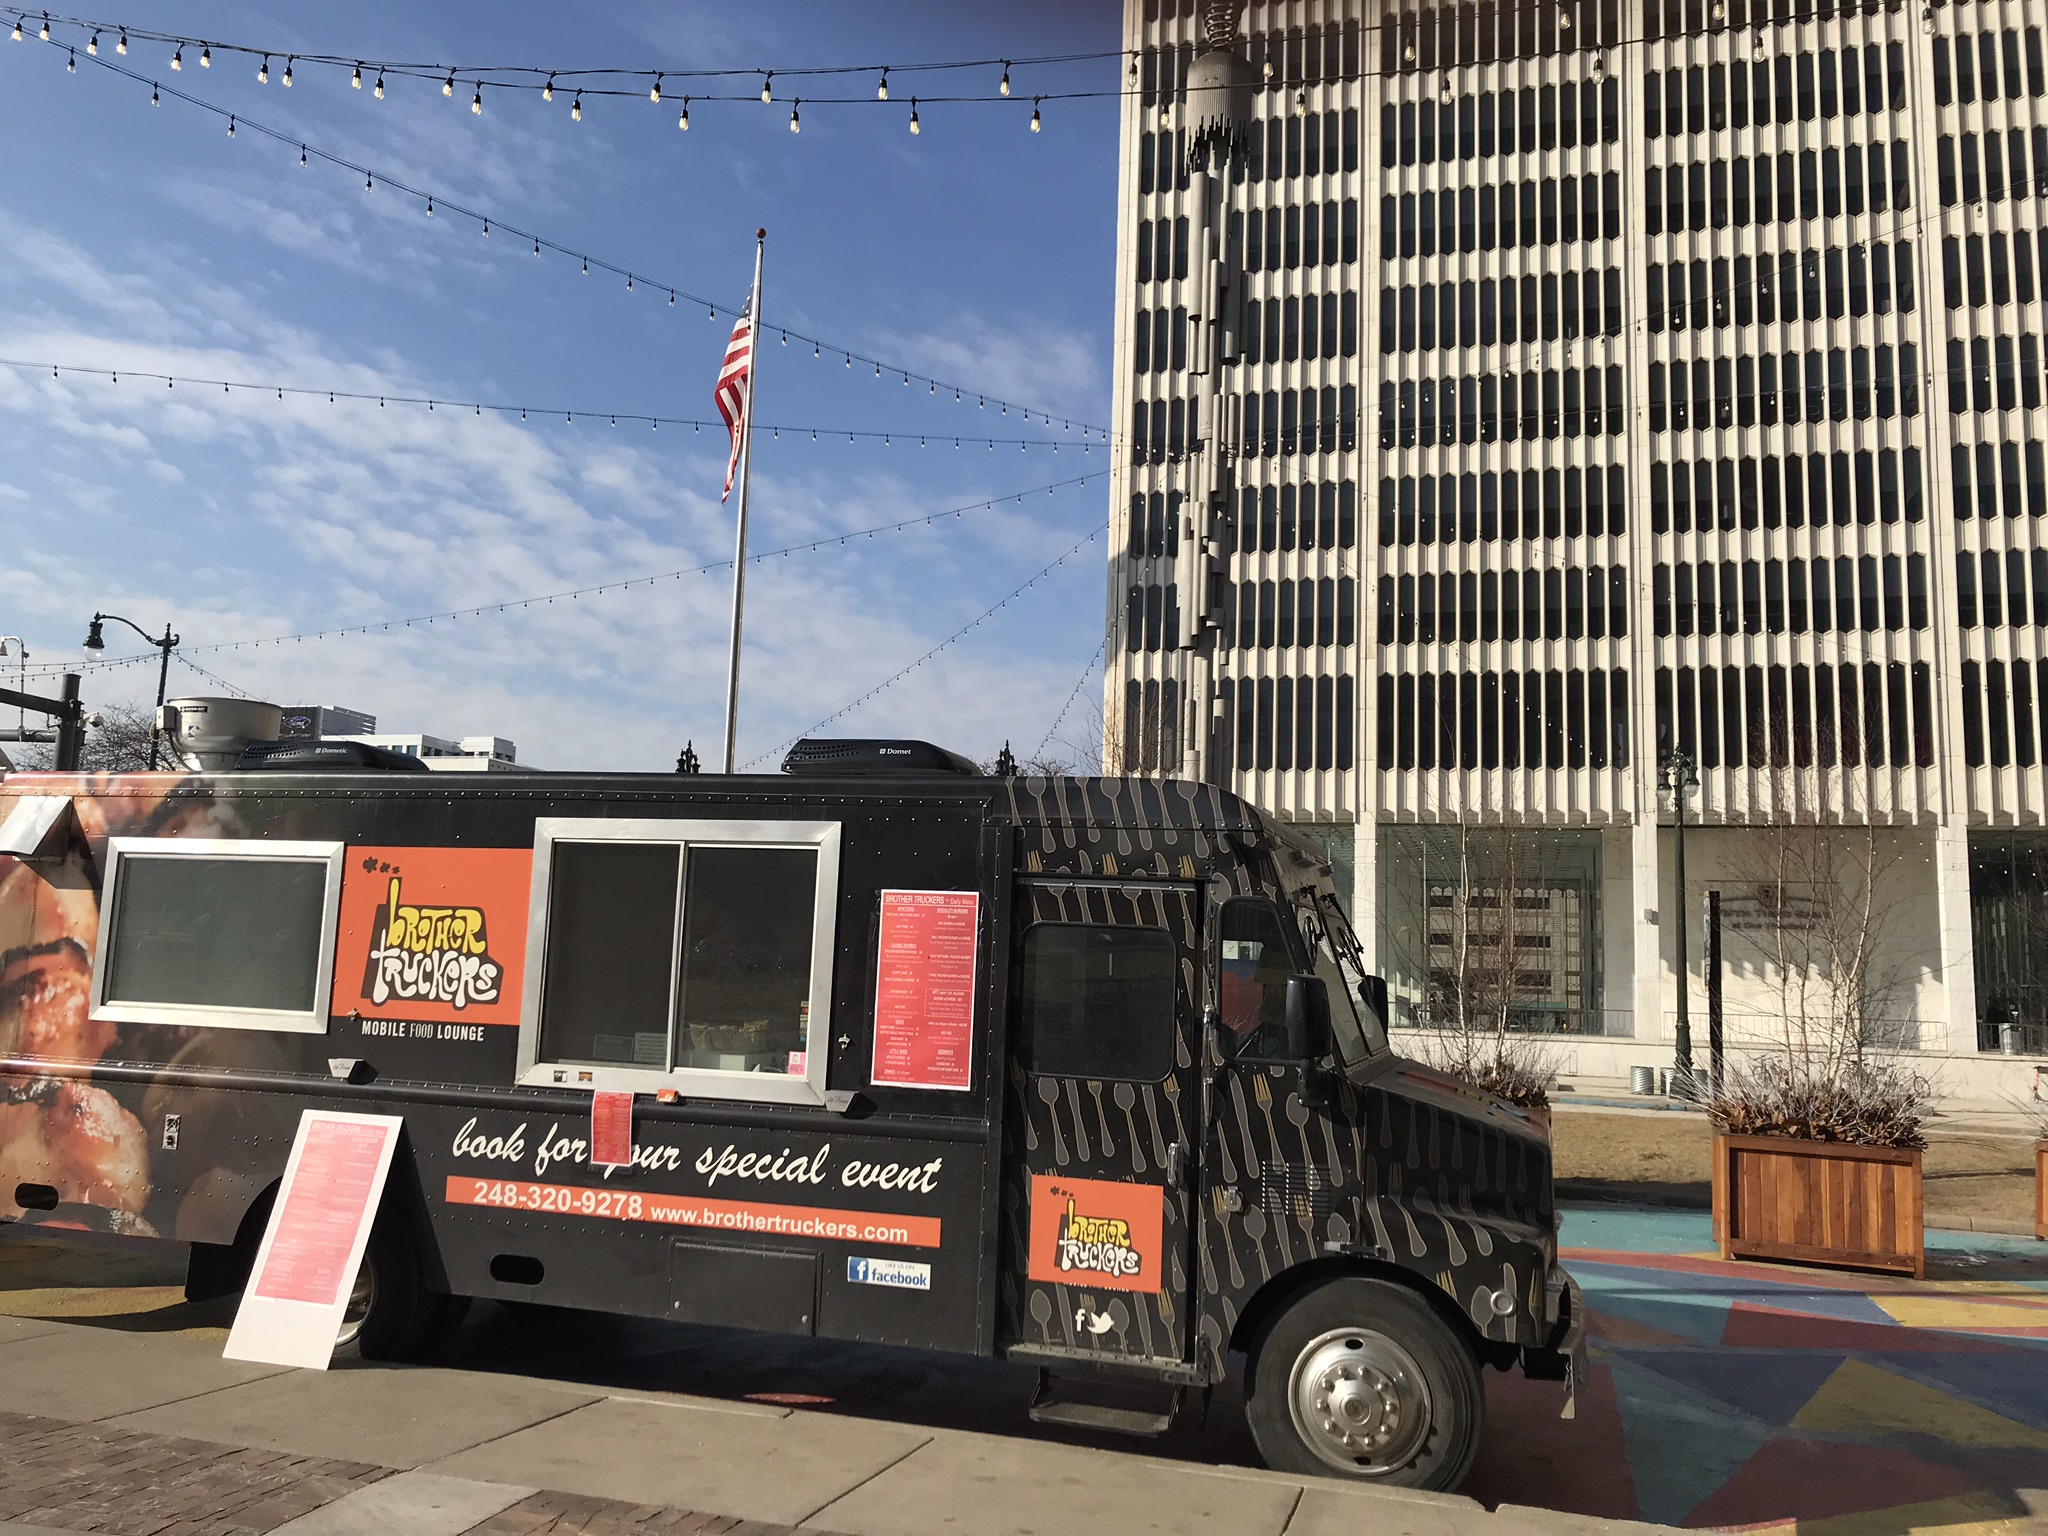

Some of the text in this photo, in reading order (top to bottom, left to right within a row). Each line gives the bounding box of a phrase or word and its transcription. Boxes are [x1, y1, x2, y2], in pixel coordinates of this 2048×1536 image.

[885, 894, 913, 903] BROTHER
[914, 895, 945, 904] TRUCKERS
[361, 1020, 485, 1041] MOBILE FOOD LOUNGE
[452, 1117, 527, 1162] book
[535, 1122, 588, 1177] for
[603, 1143, 681, 1180] our
[695, 1143, 831, 1188] special
[841, 1157, 943, 1193] event
[474, 1181, 909, 1243] 248-320-9278 www.brothertruckers.com
[872, 1268, 927, 1286] facebook
